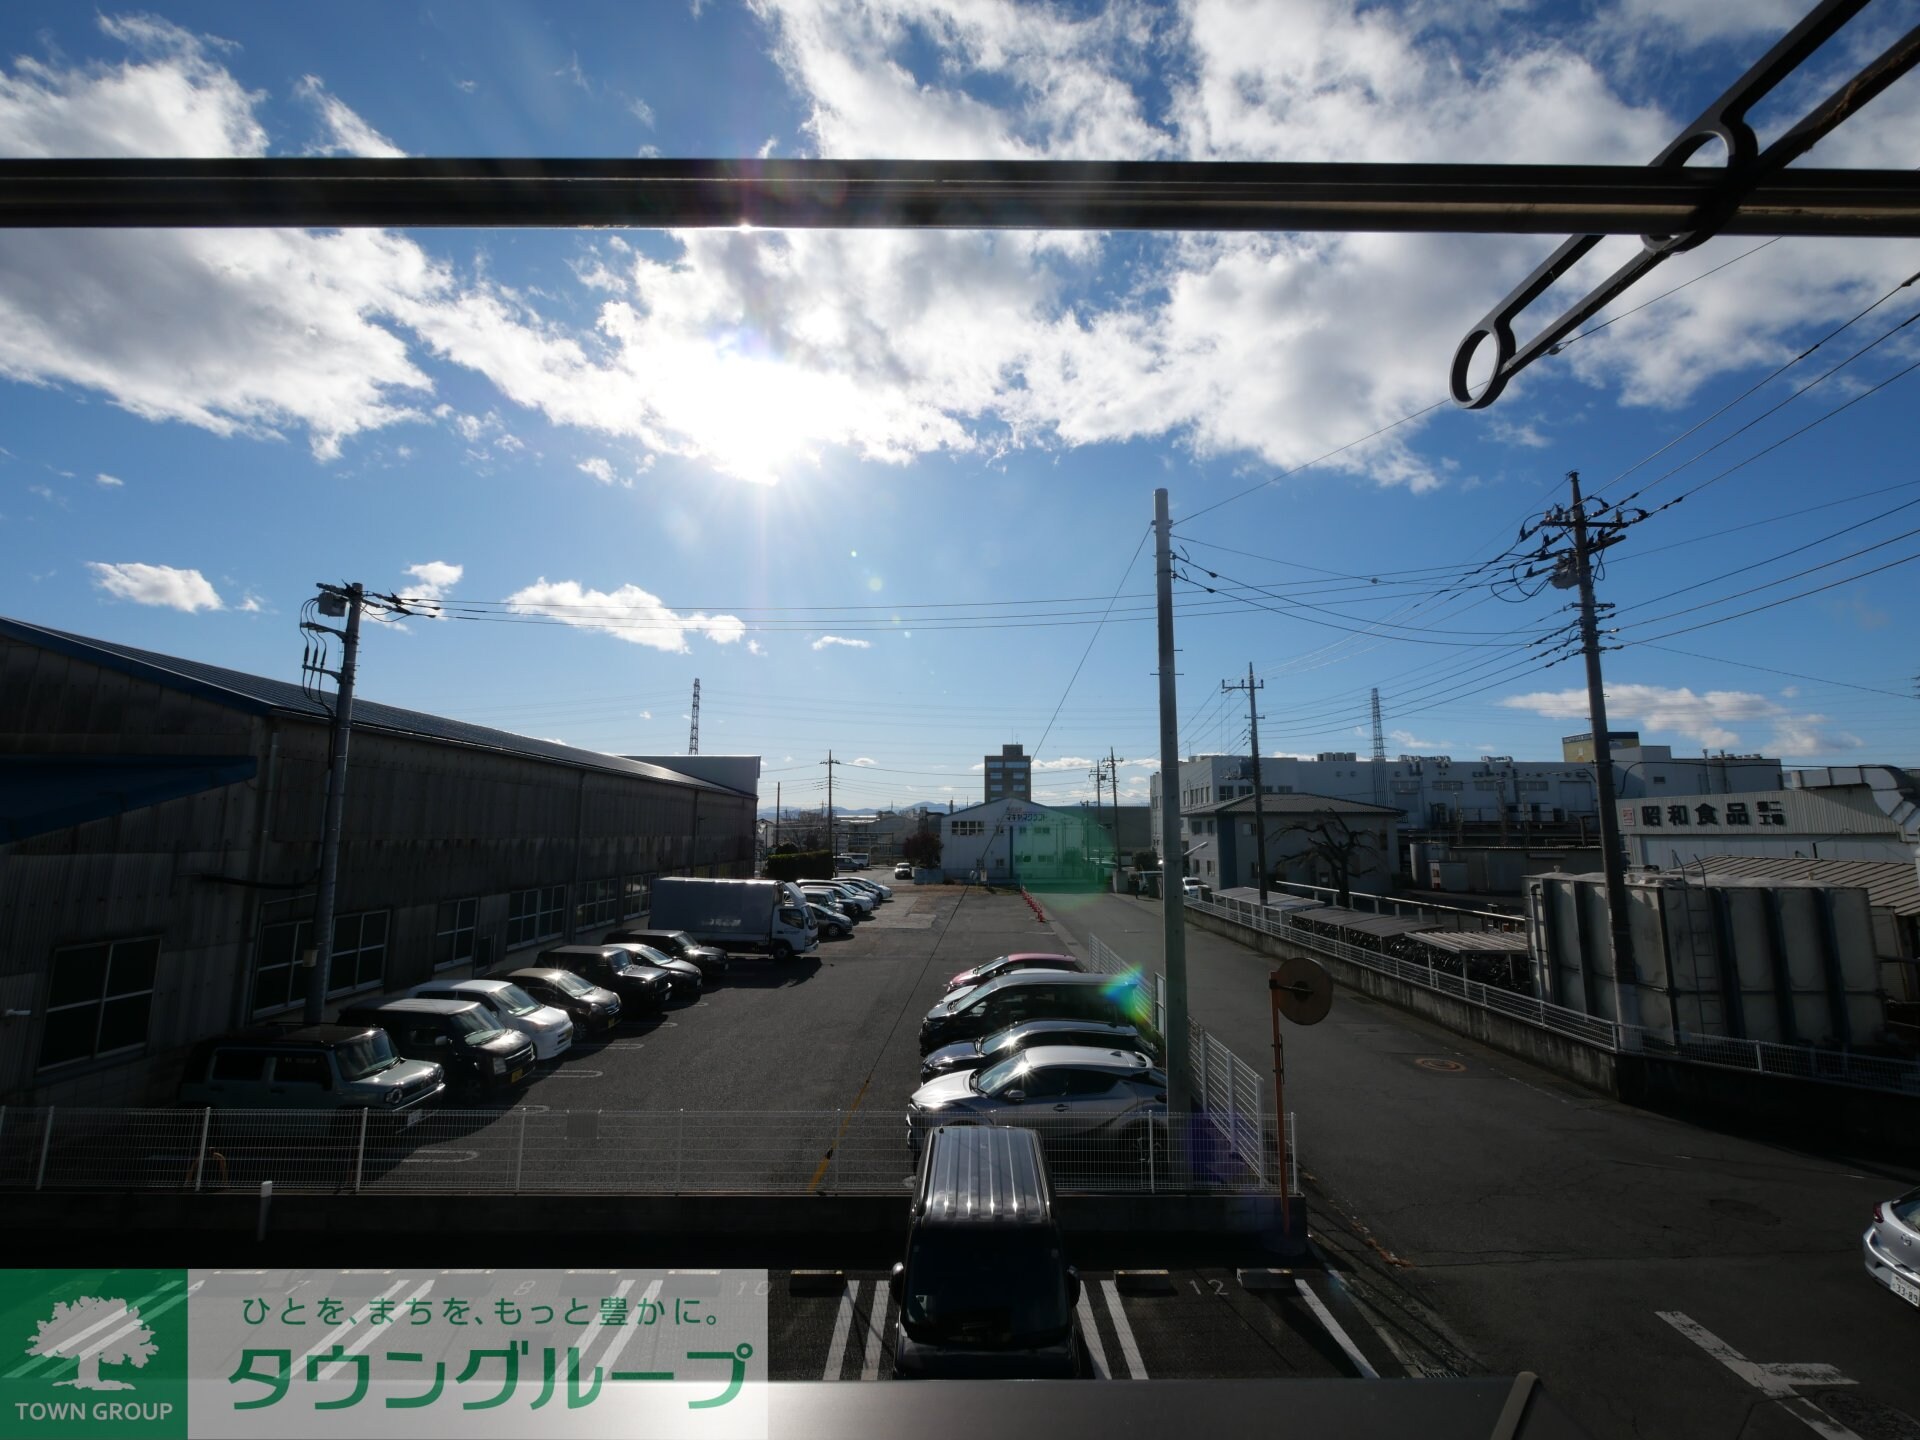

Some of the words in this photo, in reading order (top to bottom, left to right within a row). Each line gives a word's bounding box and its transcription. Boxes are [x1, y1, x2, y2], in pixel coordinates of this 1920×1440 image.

[1642, 803, 1748, 826] 昭和食品
[513, 1280, 537, 1296] 8
[736, 1280, 773, 1296] 10
[1189, 1279, 1229, 1295] 12
